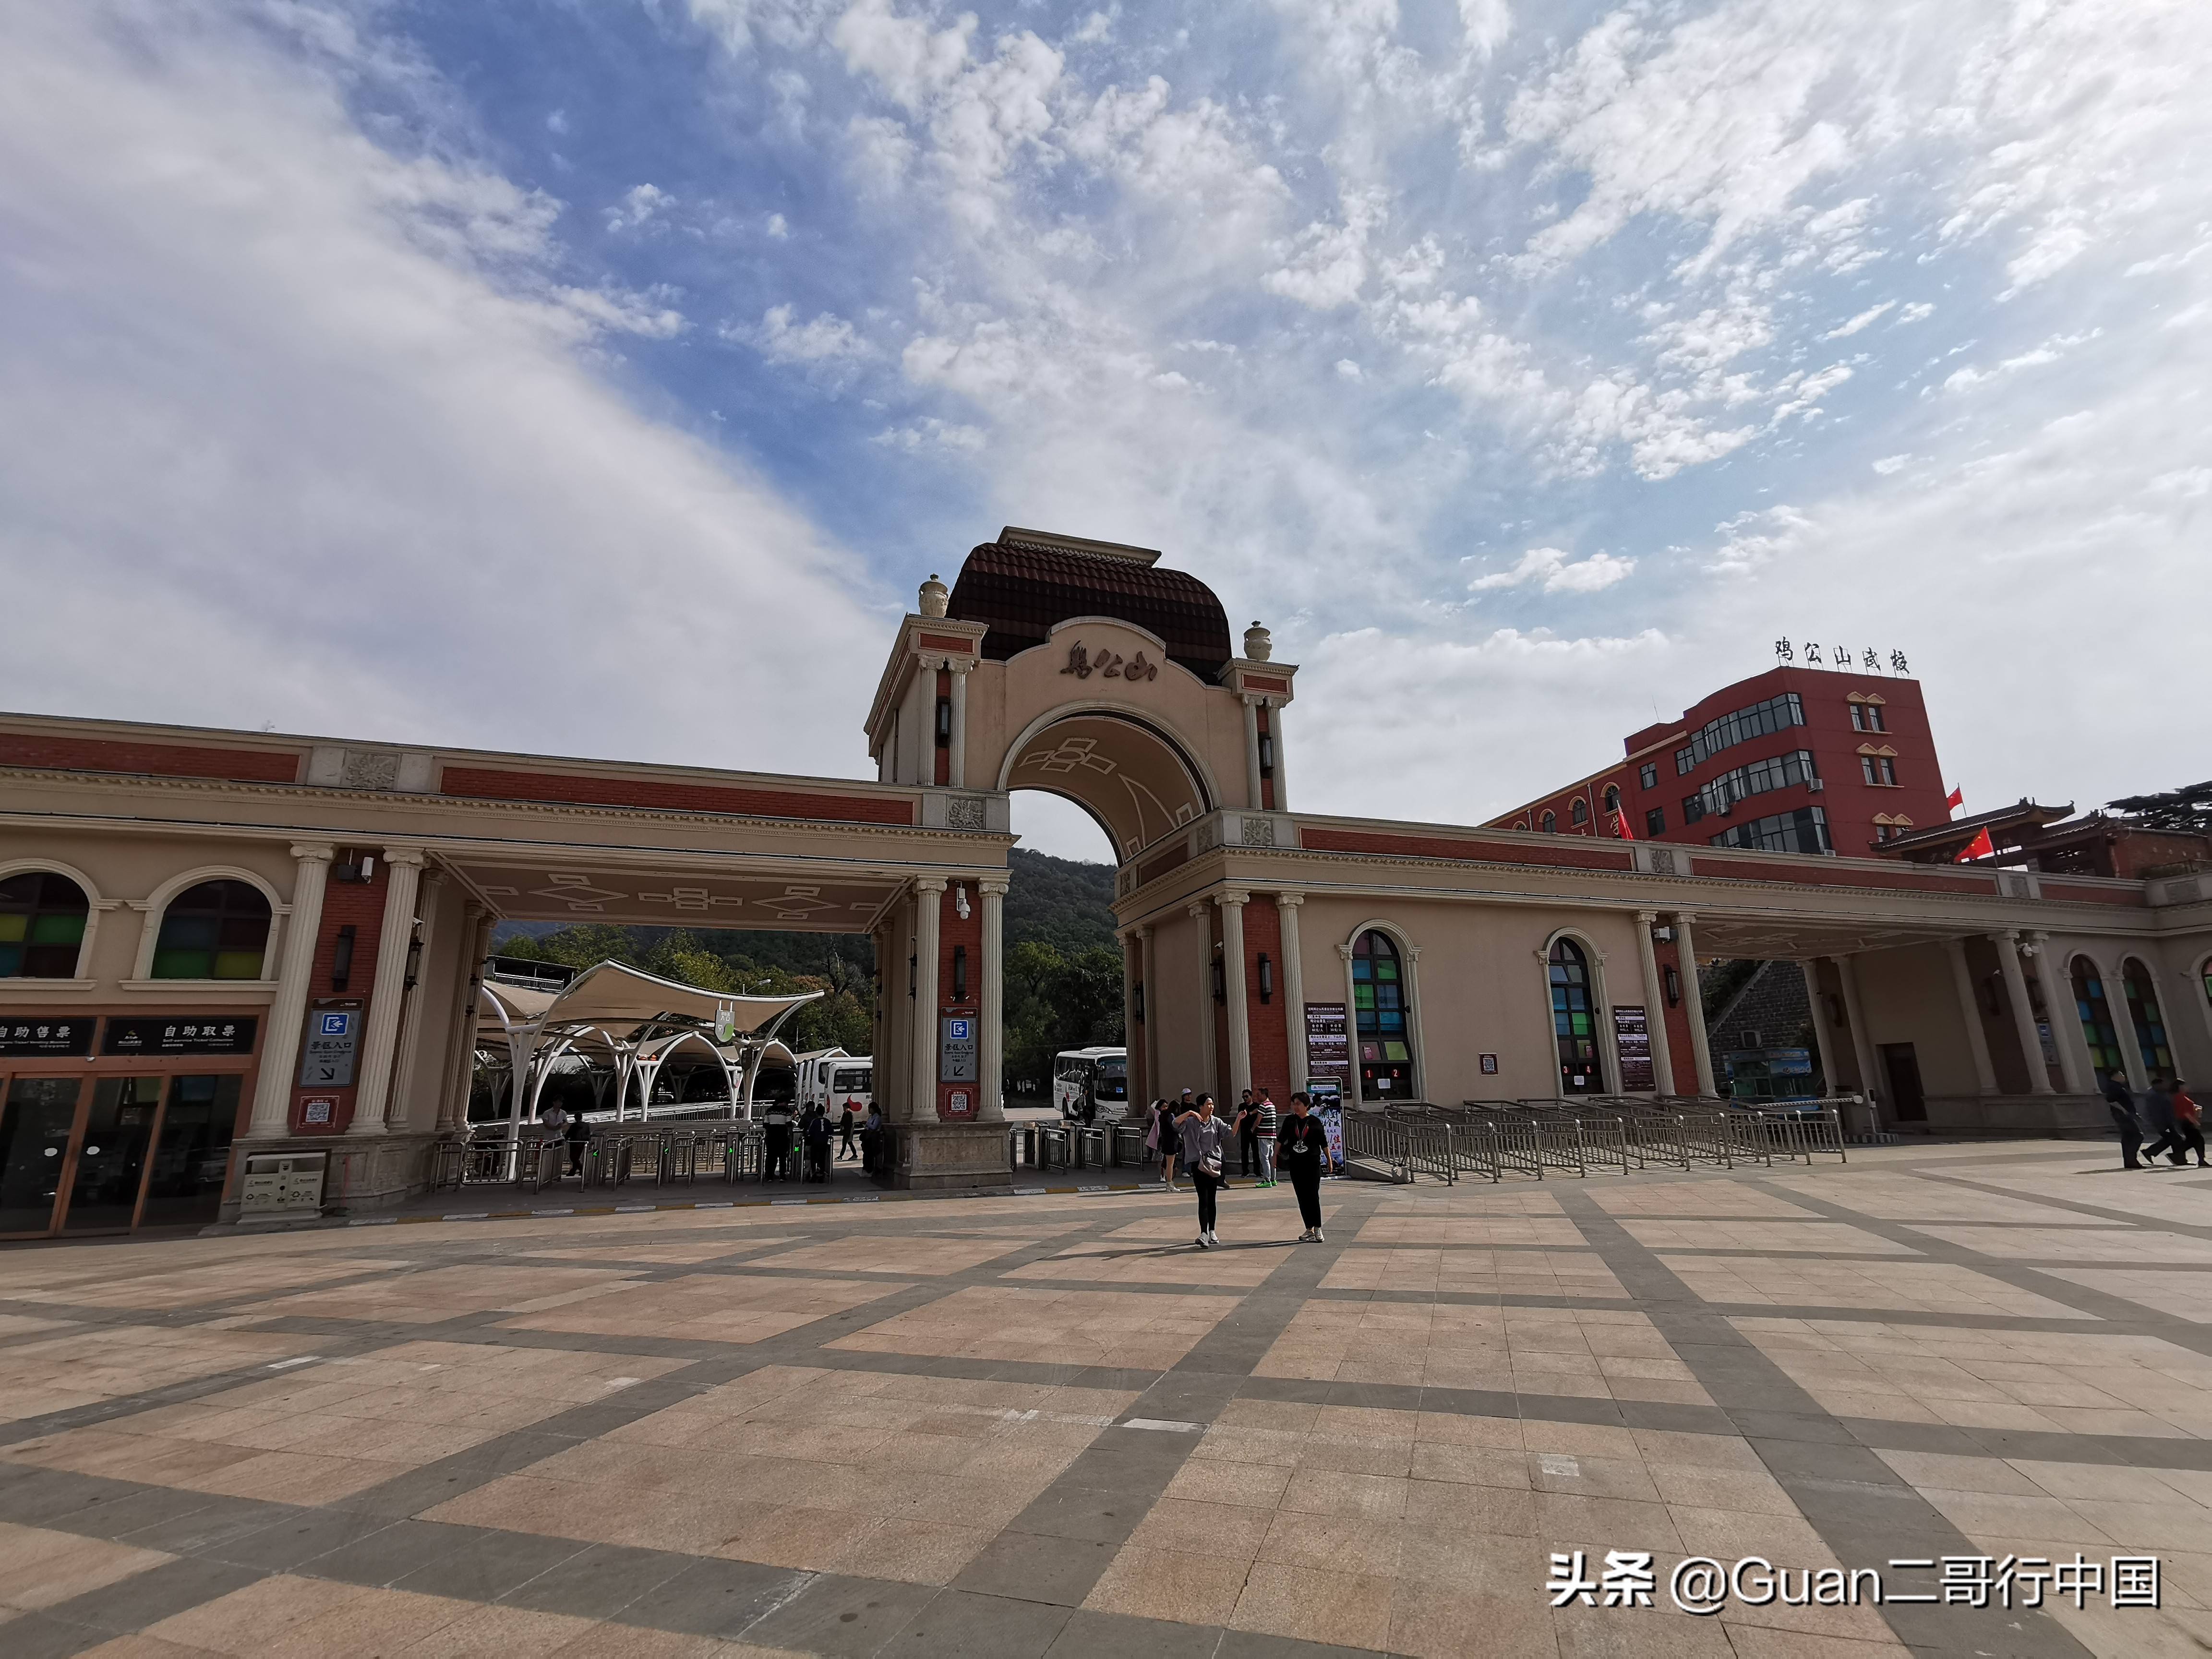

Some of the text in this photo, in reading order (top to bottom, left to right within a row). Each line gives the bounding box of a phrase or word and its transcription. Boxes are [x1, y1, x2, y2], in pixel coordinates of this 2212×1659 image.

[1775, 637, 1910, 673] 鸡公山武校
[0, 1026, 71, 1038] 自助售票
[165, 1025, 236, 1037] 自助取票
[311, 1041, 352, 1050] 景区入口
[1367, 1070, 1370, 1078] 1
[1393, 1069, 1398, 1077] 2
[1563, 1066, 1568, 1074] 3
